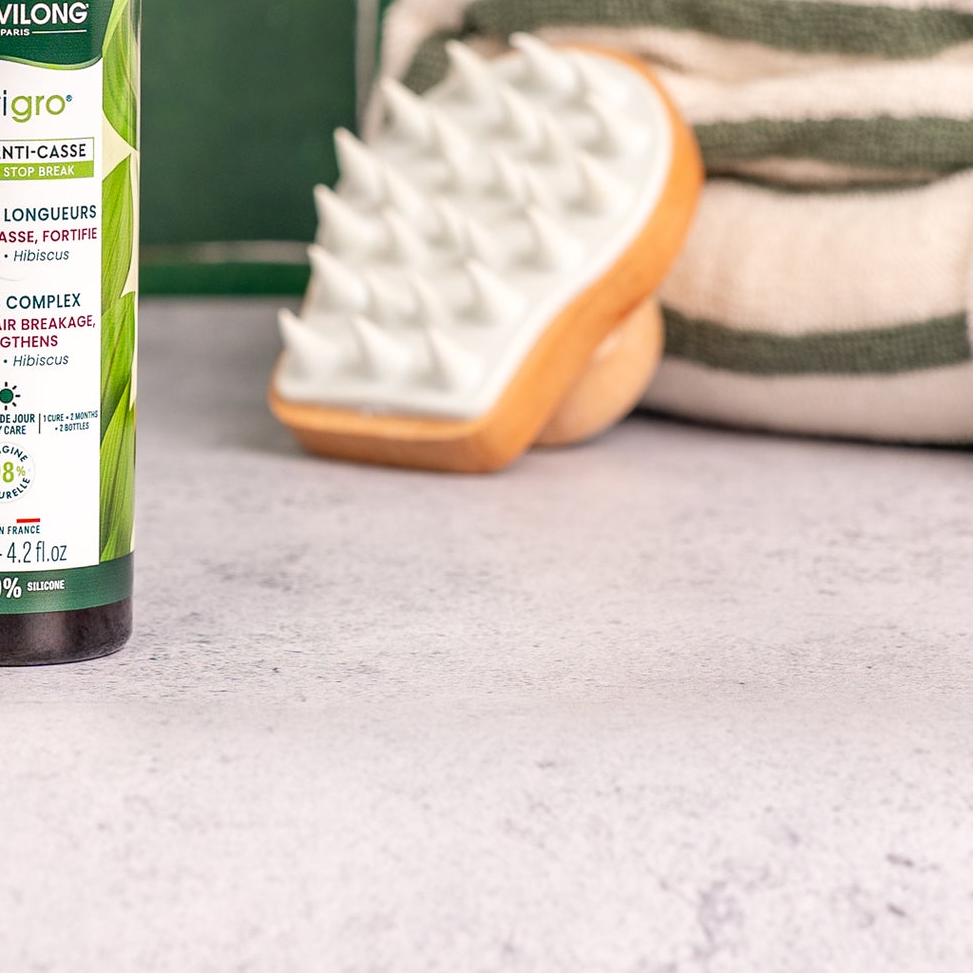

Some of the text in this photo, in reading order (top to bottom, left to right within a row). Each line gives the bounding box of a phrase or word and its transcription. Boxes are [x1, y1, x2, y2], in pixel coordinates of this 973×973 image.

[0, 28, 30, 36] PARIS
[3, 165, 75, 177] STOP BREAK
[4, 205, 97, 222] LONGUEURS
[42, 227, 97, 243] FORTIFIE
[13, 249, 70, 262] Hibiscus
[6, 293, 81, 310] COMPLEX
[21, 314, 96, 331] BREAKAGE,
[12, 354, 69, 367] Hibiscus
[0, 413, 11, 423] DE
[12, 413, 35, 423] JOUR
[47, 413, 64, 422] CURE
[74, 410, 98, 420] MONTHS
[3, 425, 26, 435] CARE
[64, 422, 89, 431] BOTTLES
[7, 525, 41, 534] FRANCE
[6, 541, 32, 563] 4.2
[27, 579, 65, 592] SILICONE
